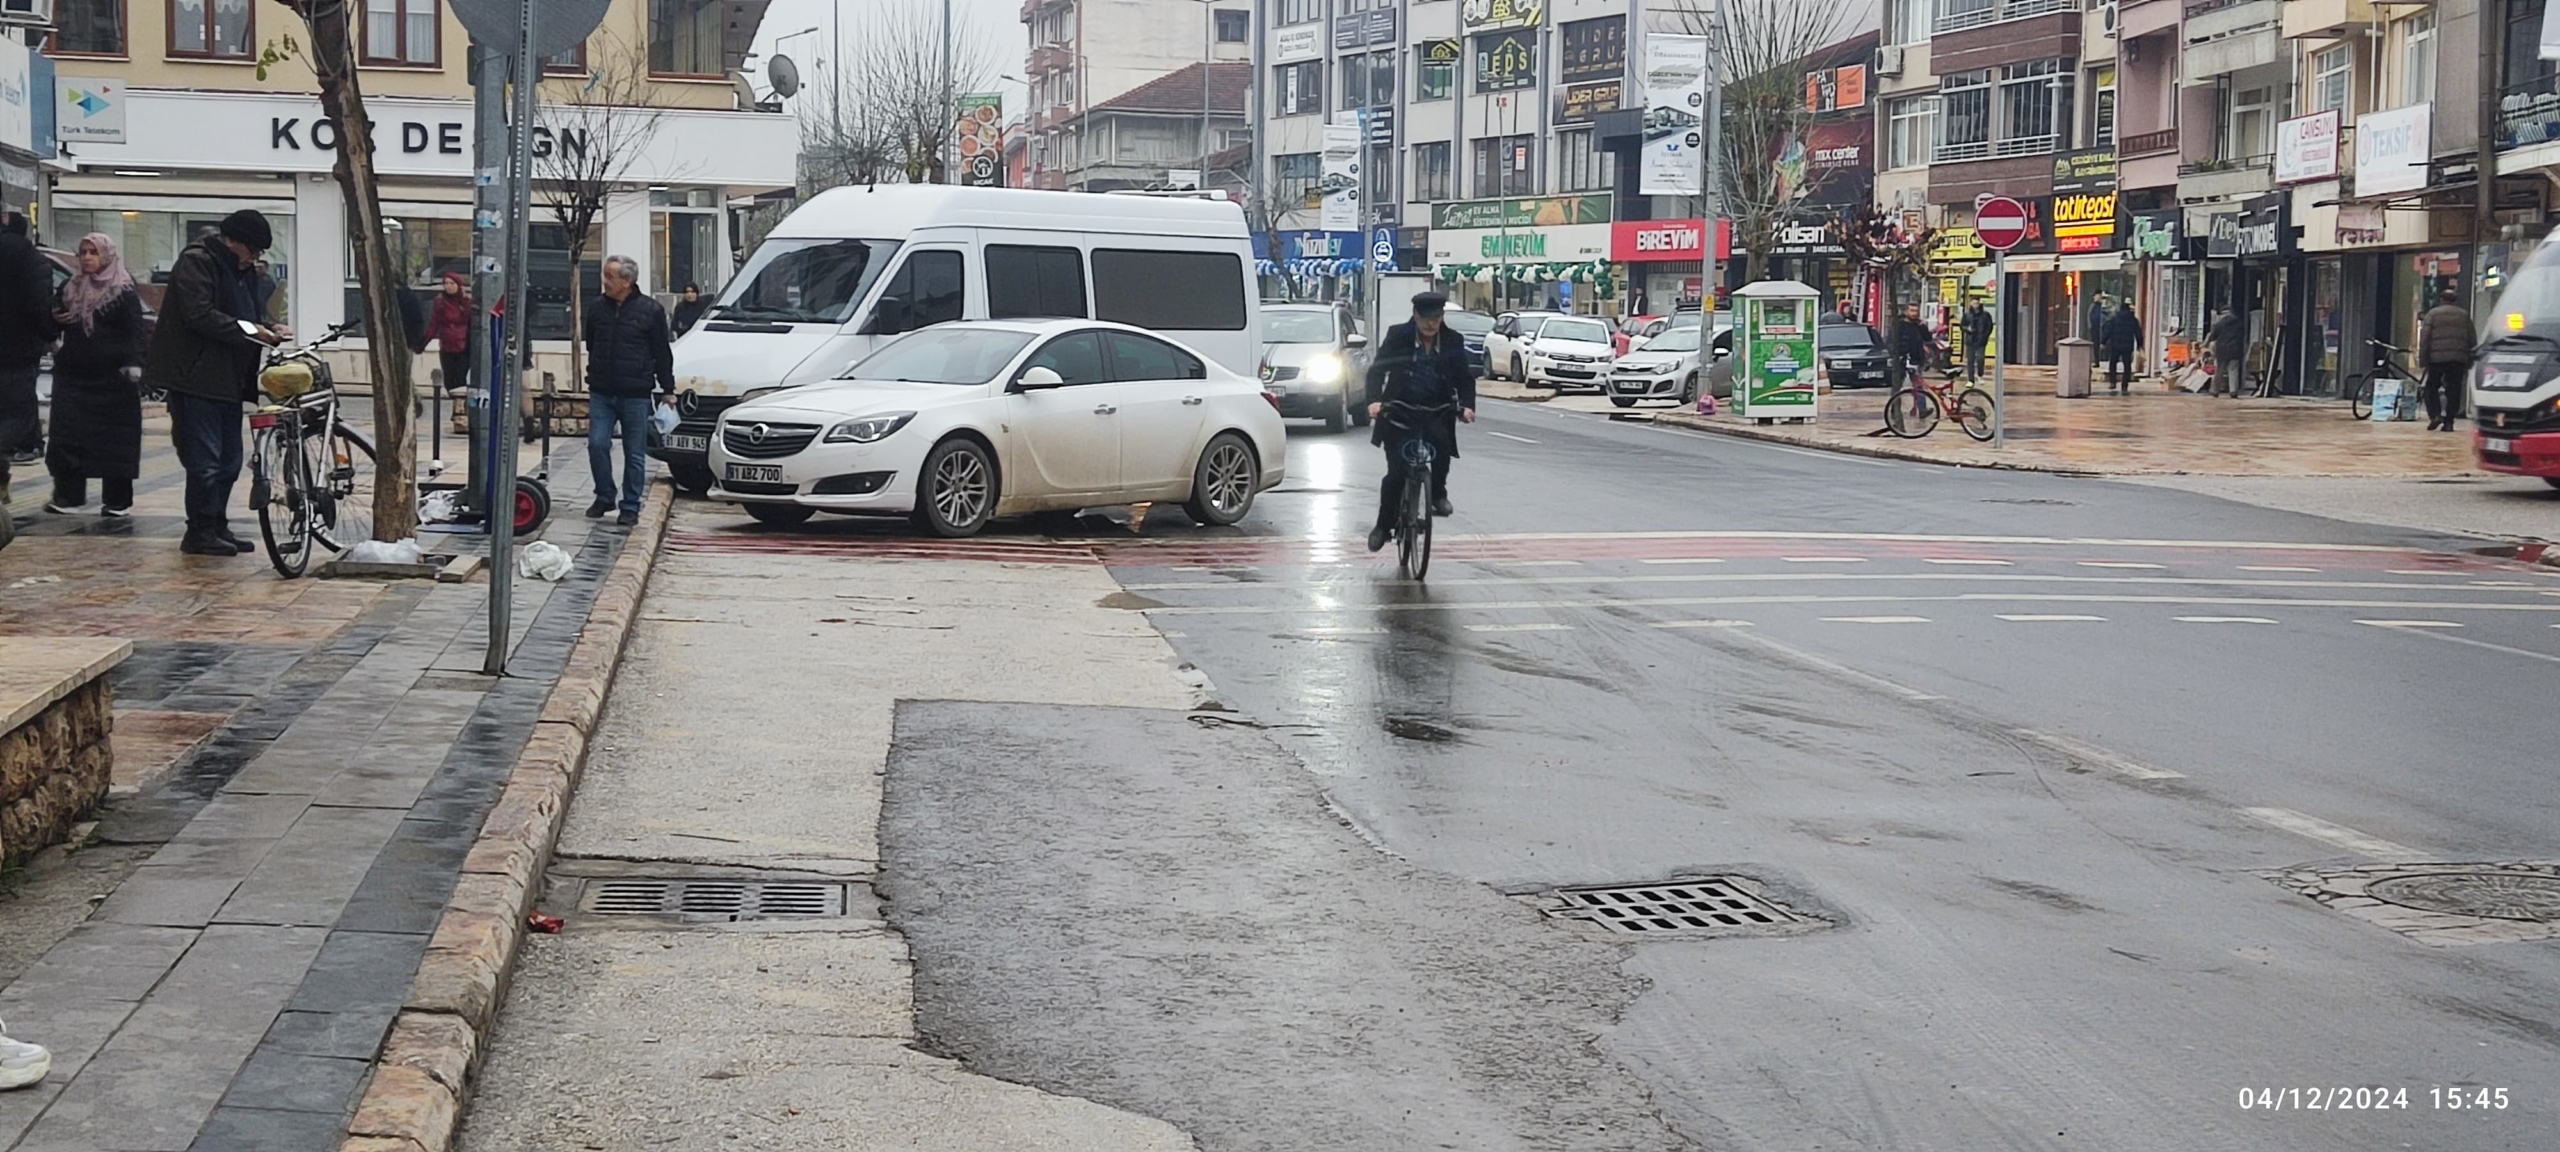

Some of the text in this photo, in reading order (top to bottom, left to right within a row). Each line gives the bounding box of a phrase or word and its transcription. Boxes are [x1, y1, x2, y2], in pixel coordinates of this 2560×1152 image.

[62, 126, 121, 135] Türk Telekom
[2300, 115, 2335, 140] CANSUYU
[272, 117, 587, 158] KO DEGN
[2372, 119, 2412, 159] TEKSİF
[1832, 145, 1860, 160] center
[1483, 205, 1500, 214] ALMA
[760, 468, 780, 482] 700
